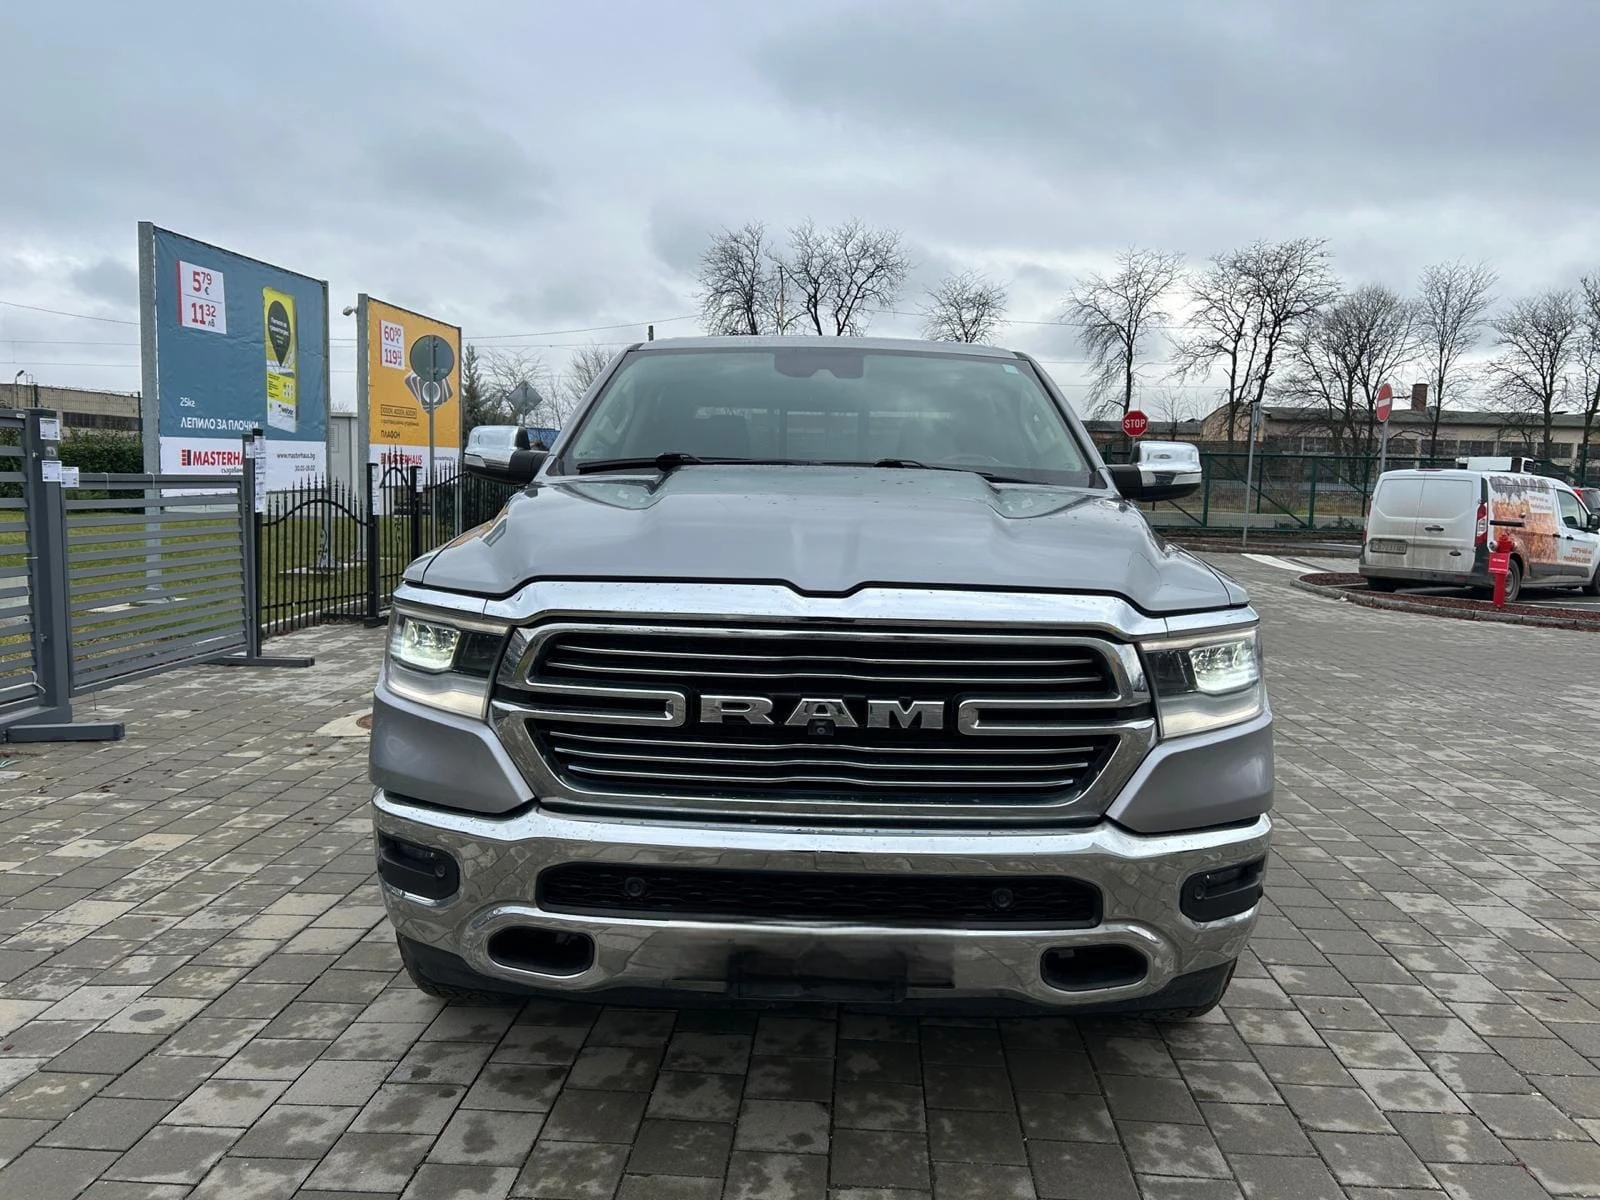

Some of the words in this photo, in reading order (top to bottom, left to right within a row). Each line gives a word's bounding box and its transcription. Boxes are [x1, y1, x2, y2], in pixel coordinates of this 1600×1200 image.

[181, 416, 216, 430] ЛЕПИЛО
[216, 419, 228, 430] ЗА
[228, 419, 259, 431] ПЛОЧКИ
[1124, 419, 1145, 429] STOP
[700, 694, 945, 729] RAM
